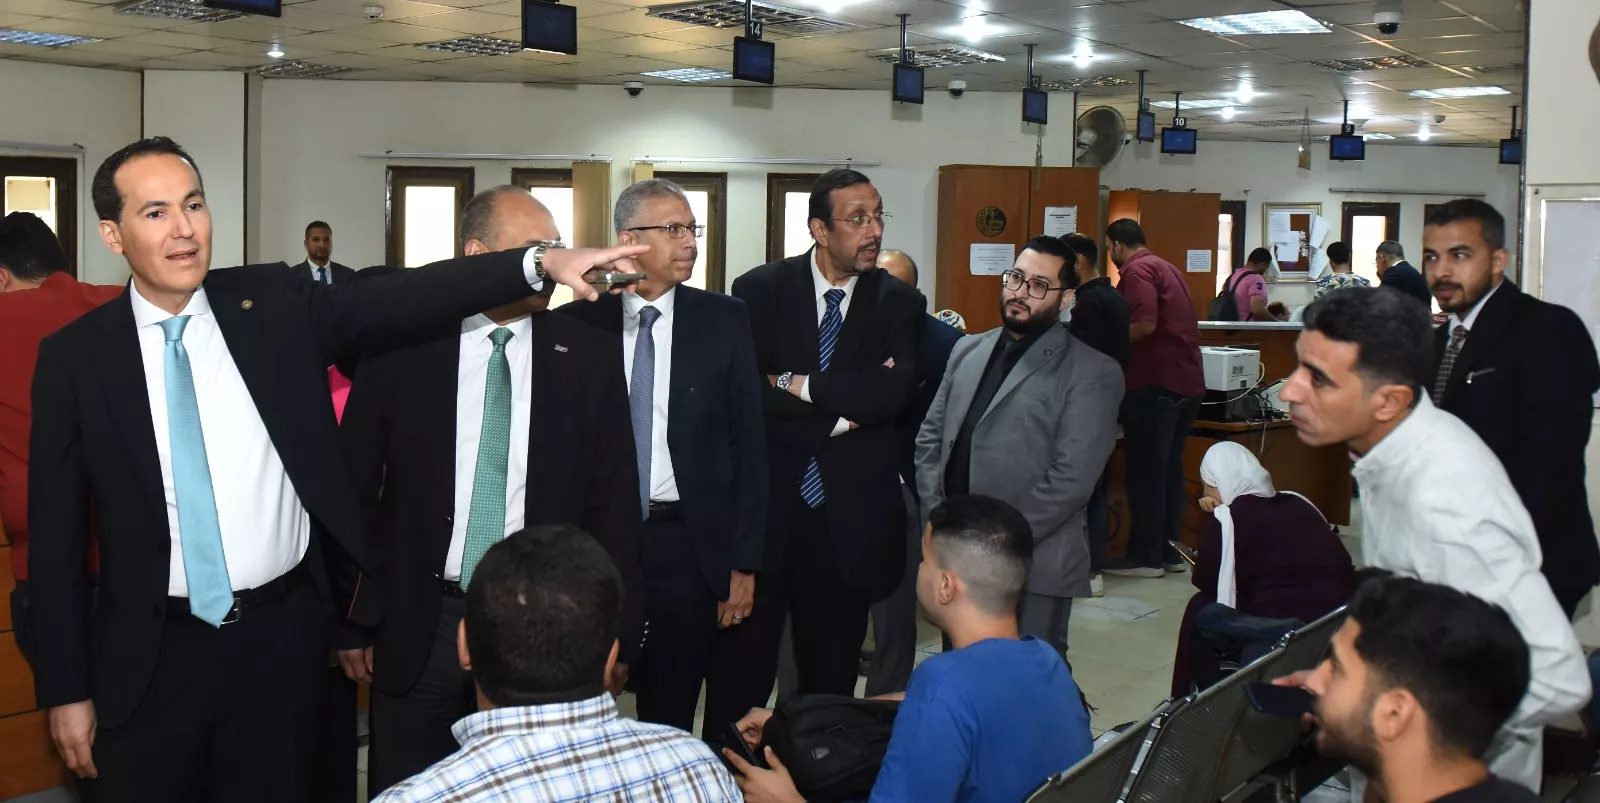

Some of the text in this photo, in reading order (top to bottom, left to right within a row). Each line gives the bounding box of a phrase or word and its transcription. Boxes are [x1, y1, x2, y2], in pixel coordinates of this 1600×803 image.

[750, 21, 761, 36] 14
[905, 50, 914, 63] 13
[1032, 76, 1039, 88] 12
[1175, 117, 1185, 126] 10
[1345, 124, 1351, 133] 9
[1256, 282, 1263, 290] 3
